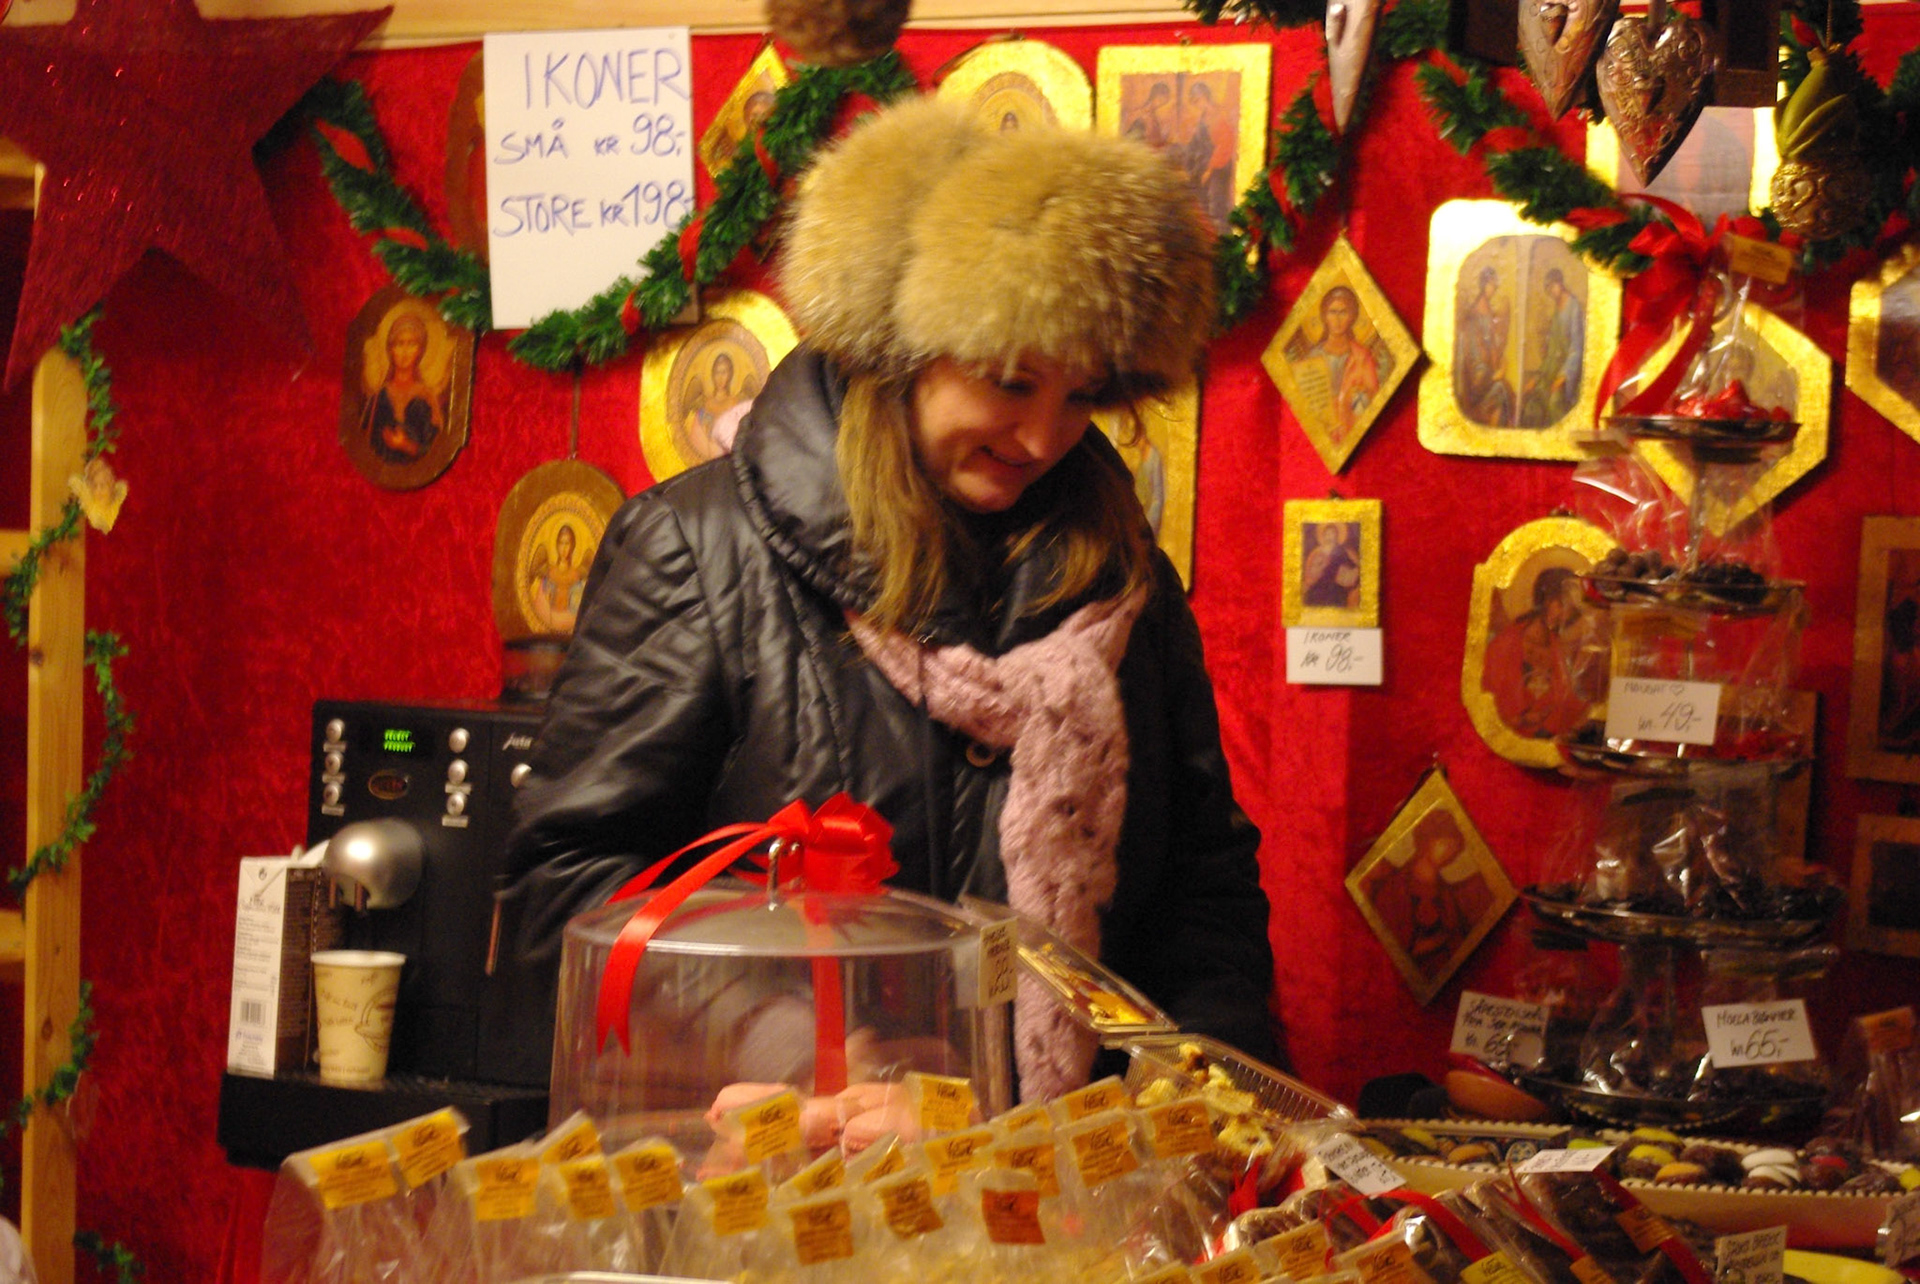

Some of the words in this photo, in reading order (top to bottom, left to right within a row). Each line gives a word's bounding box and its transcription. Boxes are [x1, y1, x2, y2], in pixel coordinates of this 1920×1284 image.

[523, 48, 691, 110] IKONER
[493, 117, 569, 165] SMÅ
[492, 192, 592, 237] STORE
